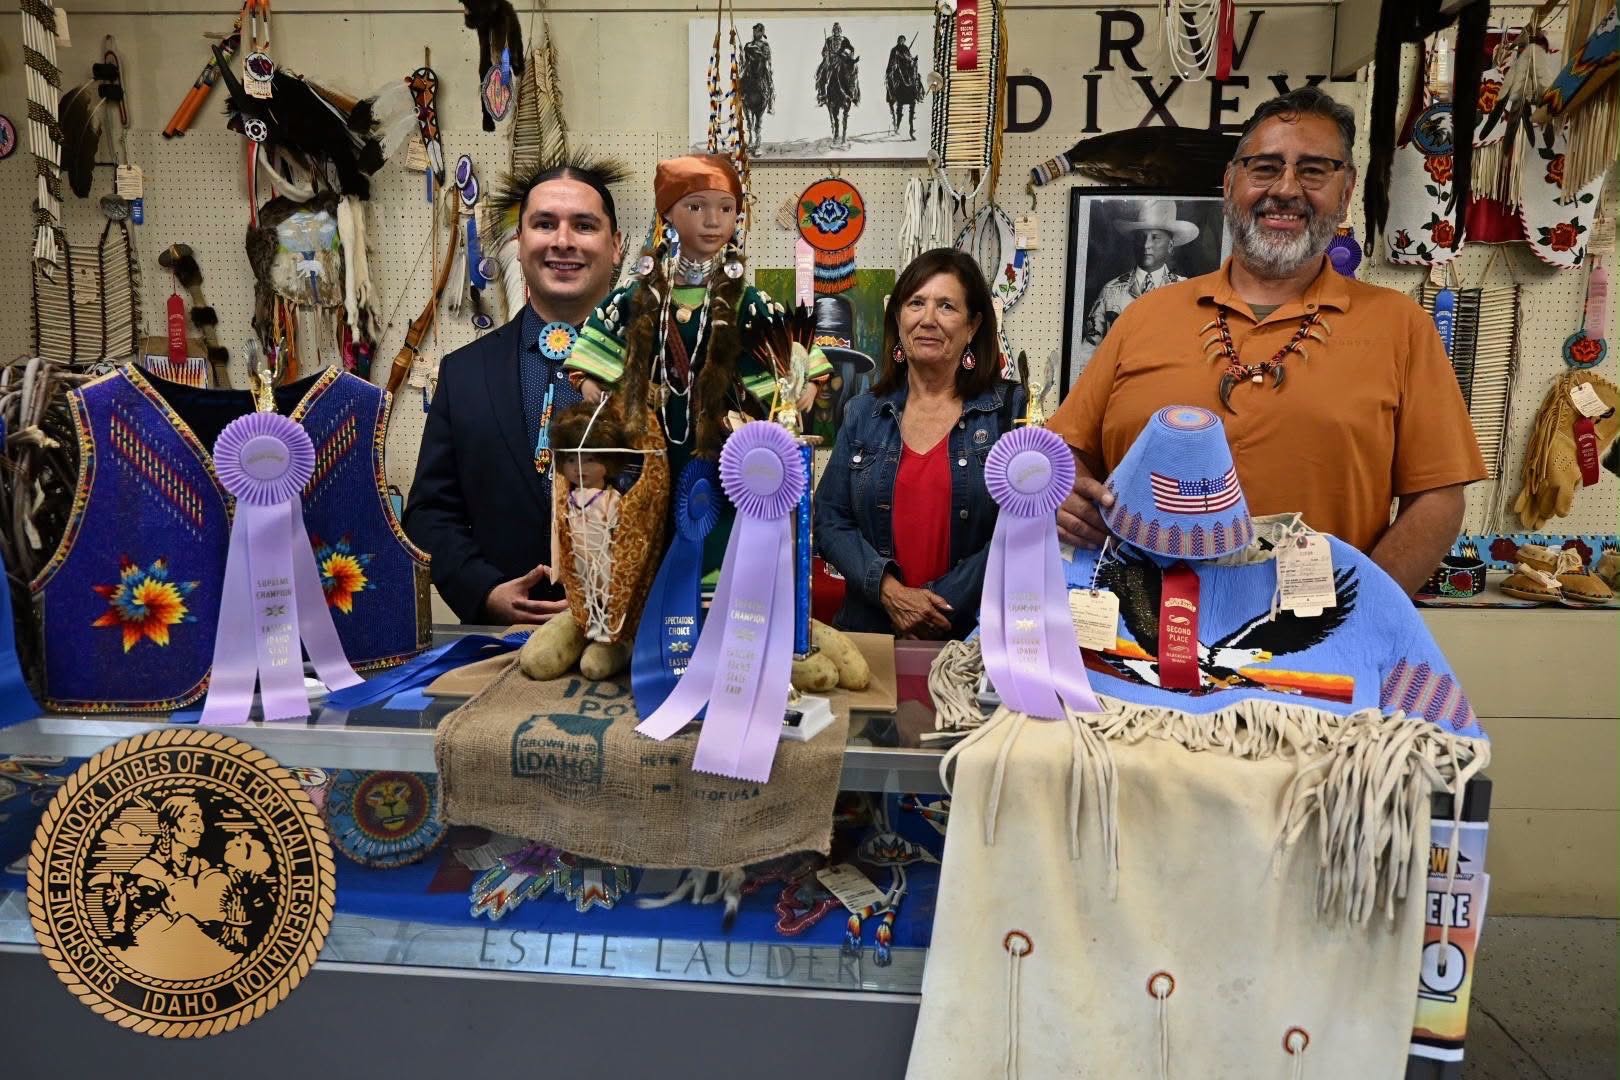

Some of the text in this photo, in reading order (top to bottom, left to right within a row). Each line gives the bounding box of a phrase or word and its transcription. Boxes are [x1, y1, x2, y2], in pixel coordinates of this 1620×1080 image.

[730, 609, 766, 624] CHAMPION
[668, 626, 691, 636] CHOICE
[1166, 624, 1192, 636] SECOND
[1169, 633, 1189, 643] PLACE
[519, 752, 595, 780] IDAHO
[50, 751, 313, 1000] SHOSHONE BANNOCK TRIBES OF THE FORT HALL RESERVATION
[479, 928, 863, 984] ESTEE LAUDER
[142, 991, 217, 1016] IDAHO
